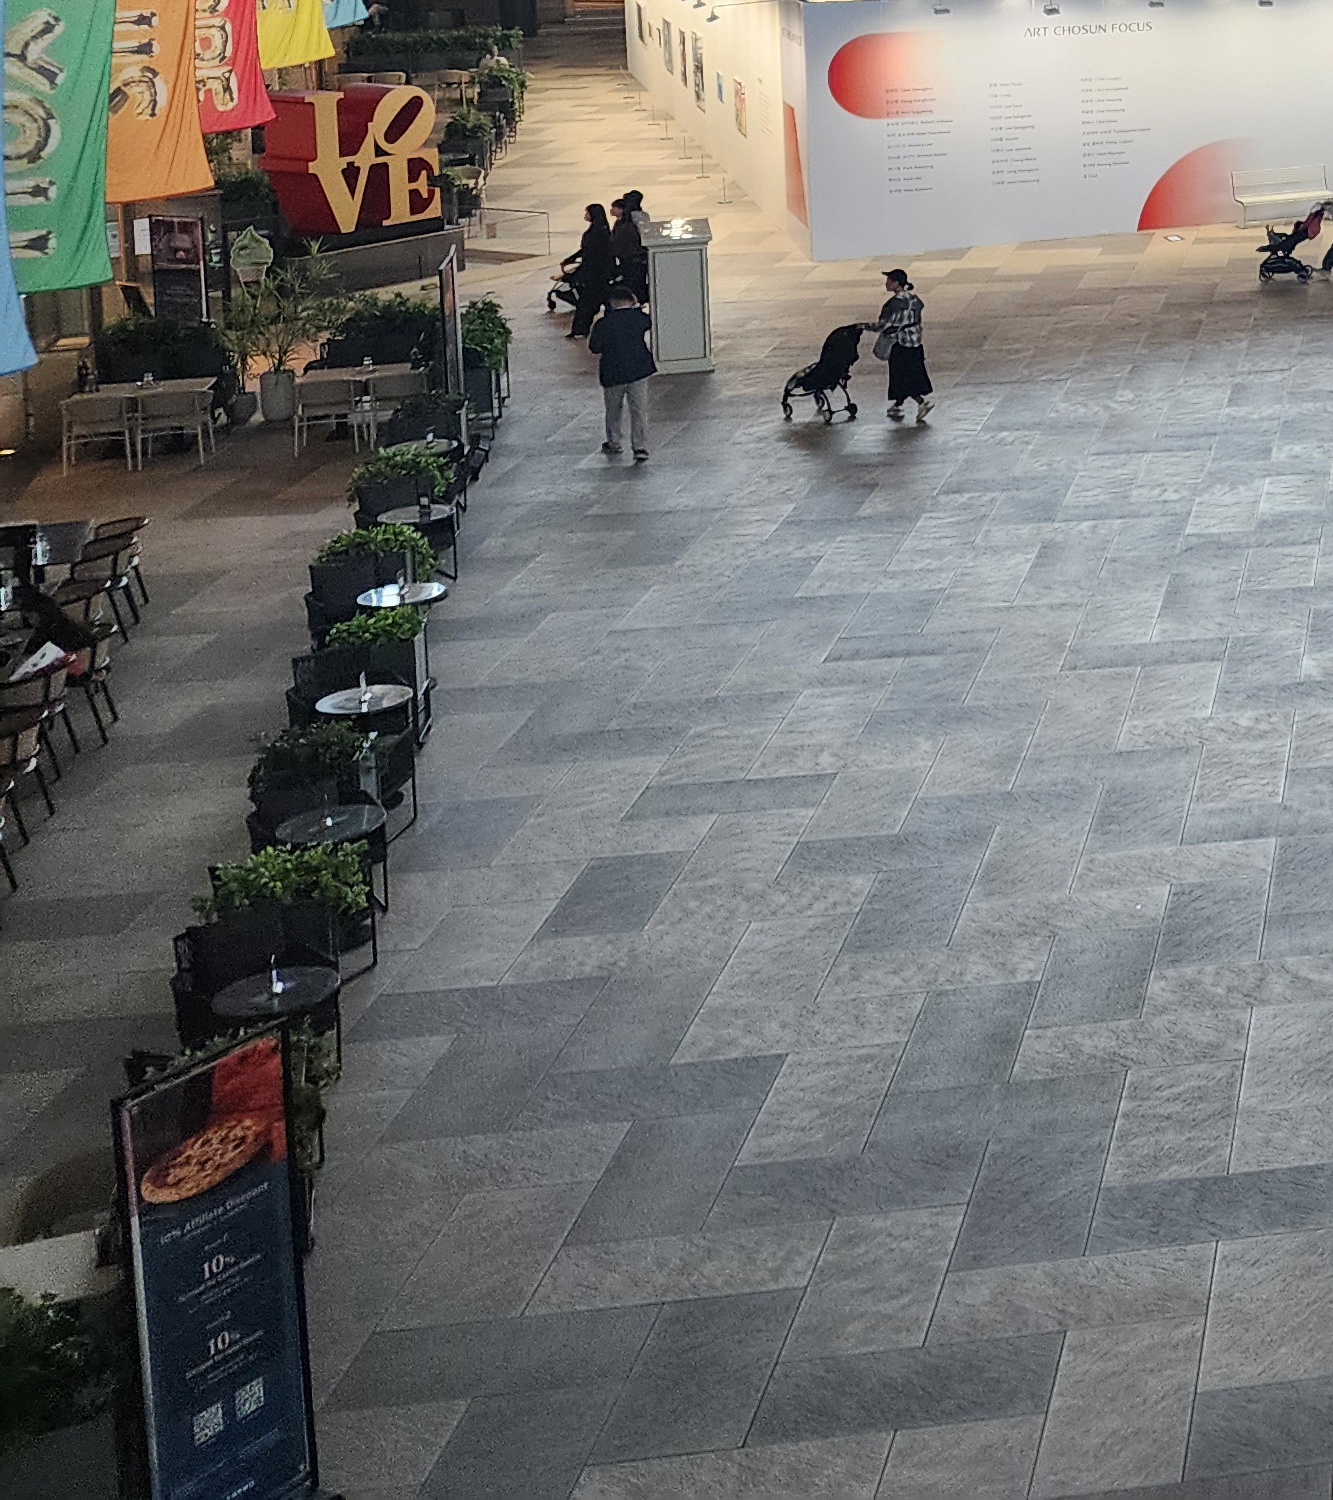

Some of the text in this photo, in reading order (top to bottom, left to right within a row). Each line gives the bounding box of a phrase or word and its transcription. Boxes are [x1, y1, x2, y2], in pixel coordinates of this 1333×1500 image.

[1024, 21, 1153, 38] ART CHOSUN FOCUS
